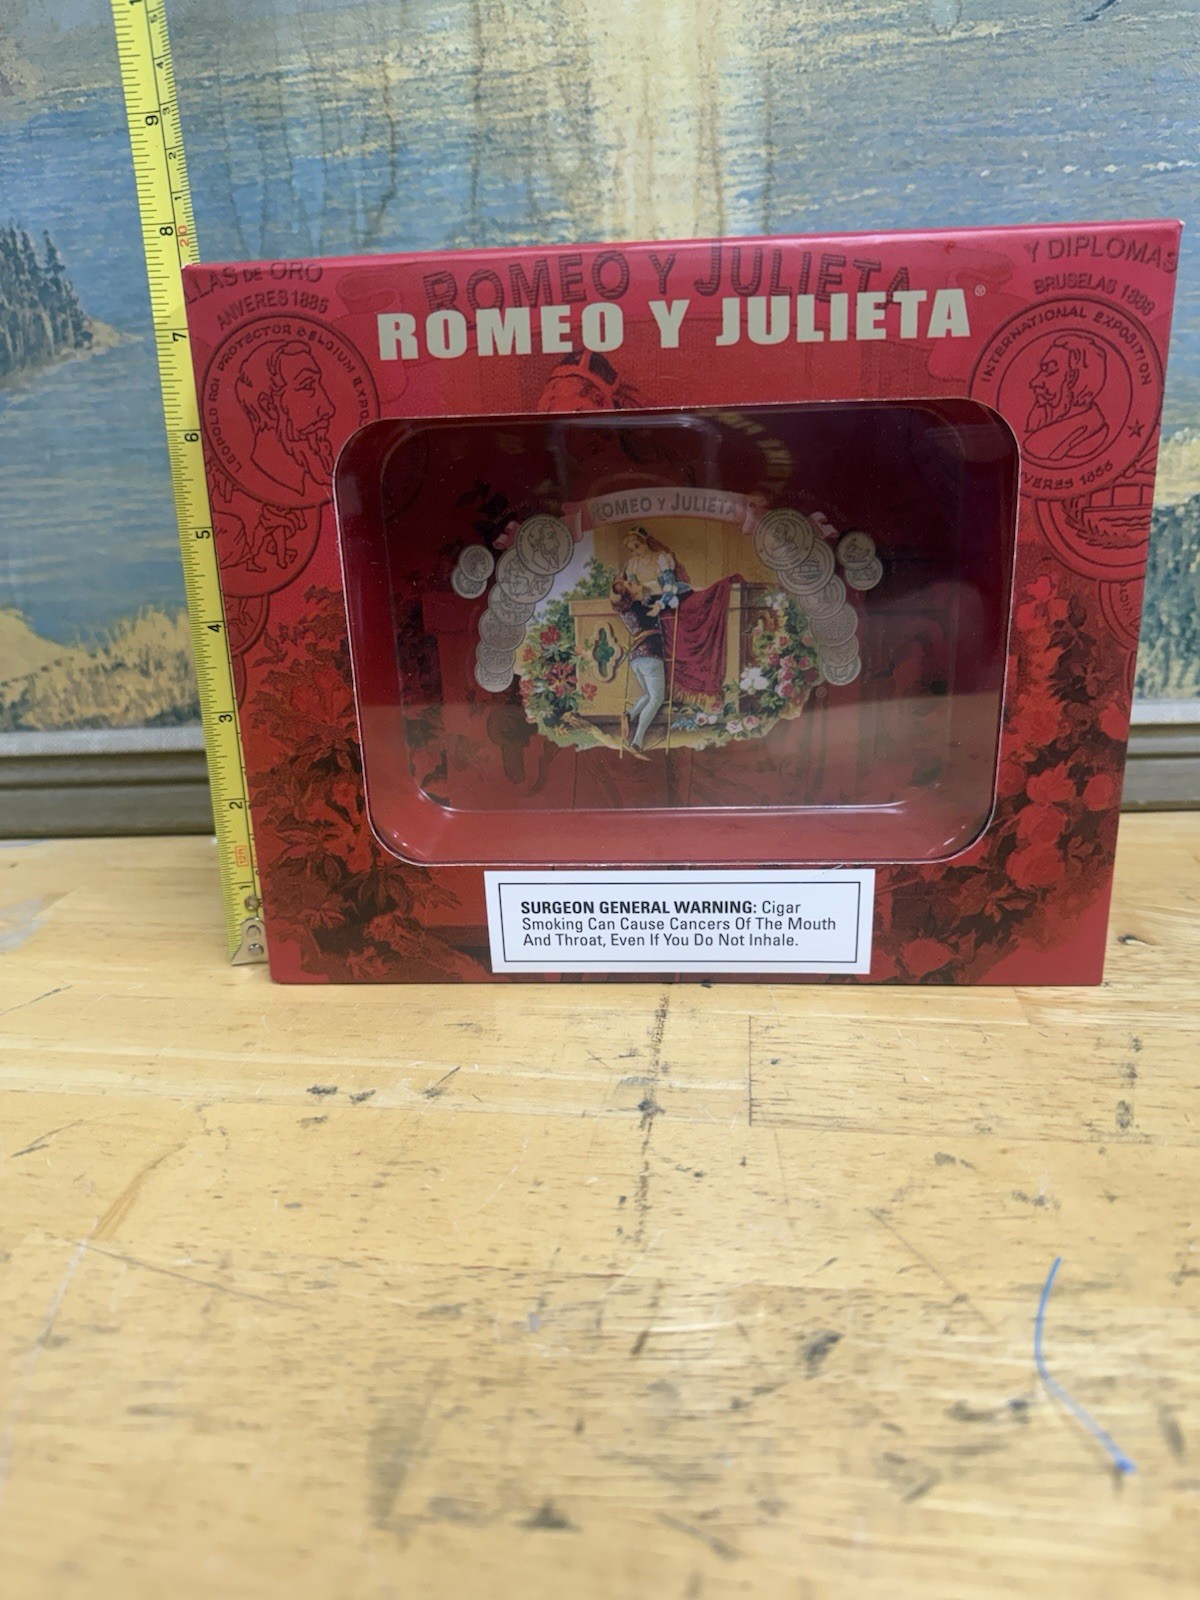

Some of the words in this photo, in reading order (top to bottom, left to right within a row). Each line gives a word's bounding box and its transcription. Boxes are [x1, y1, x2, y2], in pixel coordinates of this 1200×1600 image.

[156, 61, 164, 70] 4
[144, 114, 160, 126] 9
[168, 151, 177, 160] 2
[159, 226, 174, 236] 8
[177, 225, 190, 247] 20
[1024, 240, 1040, 264] Y
[1048, 234, 1178, 274] DIPLOMAS
[269, 261, 324, 284] ORO
[648, 252, 677, 295] Y
[1033, 272, 1118, 295] BRUSELAS
[217, 289, 289, 331] ANVERES
[172, 331, 188, 343] 7
[376, 303, 624, 361] ROMEO
[647, 299, 690, 349] Y
[217, 324, 291, 372] PROTECTOR
[981, 303, 1088, 382] INTERNATIONAL
[1092, 310, 1152, 387] EXPOSITION
[207, 378, 221, 403] ROI
[184, 430, 200, 443] 6
[206, 404, 243, 474] LEOPOLD
[589, 495, 653, 522] ROMEO
[670, 492, 738, 518] JULIETA
[195, 529, 211, 540] 5
[206, 623, 223, 633] 4
[218, 712, 233, 724] 3
[229, 800, 244, 810] 2
[520, 900, 595, 915] SURGEON
[599, 900, 671, 915] GENERAL
[674, 900, 758, 915] WARNING:
[761, 900, 801, 917] Cigar
[522, 917, 584, 933] Smoking
[587, 917, 616, 931] Can
[619, 917, 666, 931] Cause
[669, 917, 731, 931] Cancers
[734, 917, 753, 931] Of
[754, 917, 783, 931] The
[787, 917, 837, 931] Mouth
[522, 933, 552, 947] And
[555, 933, 607, 949] Throat,
[610, 933, 645, 947] Even
[649, 933, 661, 947] If
[663, 933, 690, 947] You
[693, 933, 713, 947] Do
[718, 933, 745, 947] Not
[749, 933, 799, 947] Inhale.
